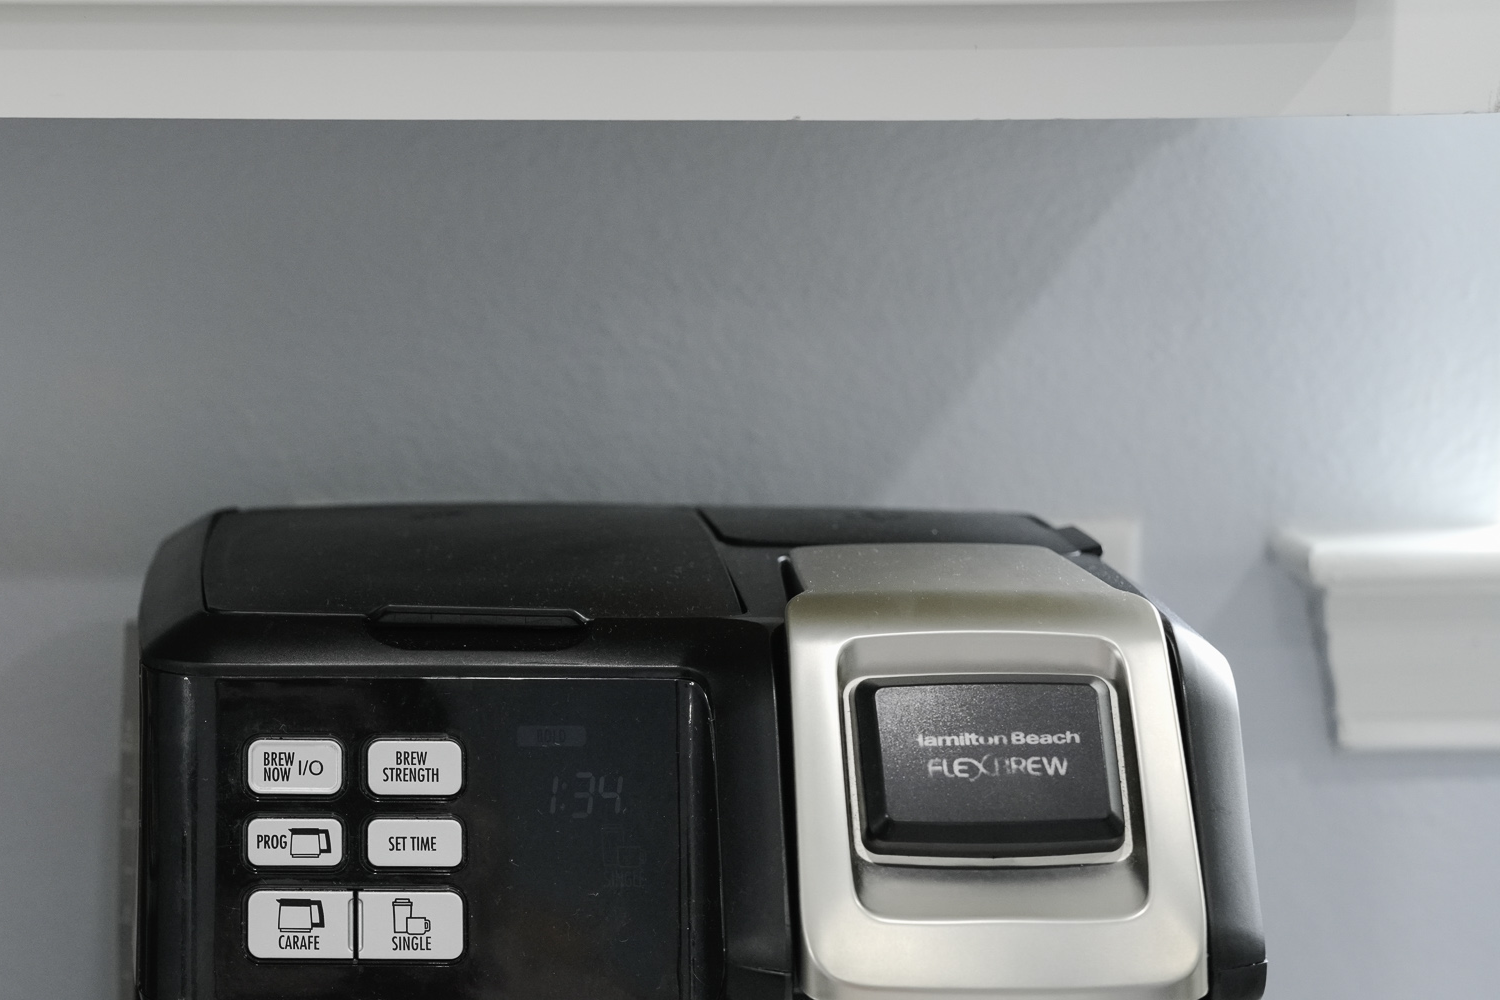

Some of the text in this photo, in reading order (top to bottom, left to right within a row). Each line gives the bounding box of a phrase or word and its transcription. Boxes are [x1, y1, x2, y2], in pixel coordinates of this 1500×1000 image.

[1011, 731, 1080, 745] Beach
[263, 752, 295, 766] BREW
[395, 751, 427, 765] BREW
[263, 767, 291, 781] NOW
[299, 760, 323, 775] I/O
[383, 768, 439, 782] STRENGTH
[549, 771, 623, 818] 1:34
[256, 834, 288, 849] PROG
[389, 836, 436, 851] SET TIME
[278, 935, 320, 950] CARAFE
[392, 936, 431, 951] SINGLE
